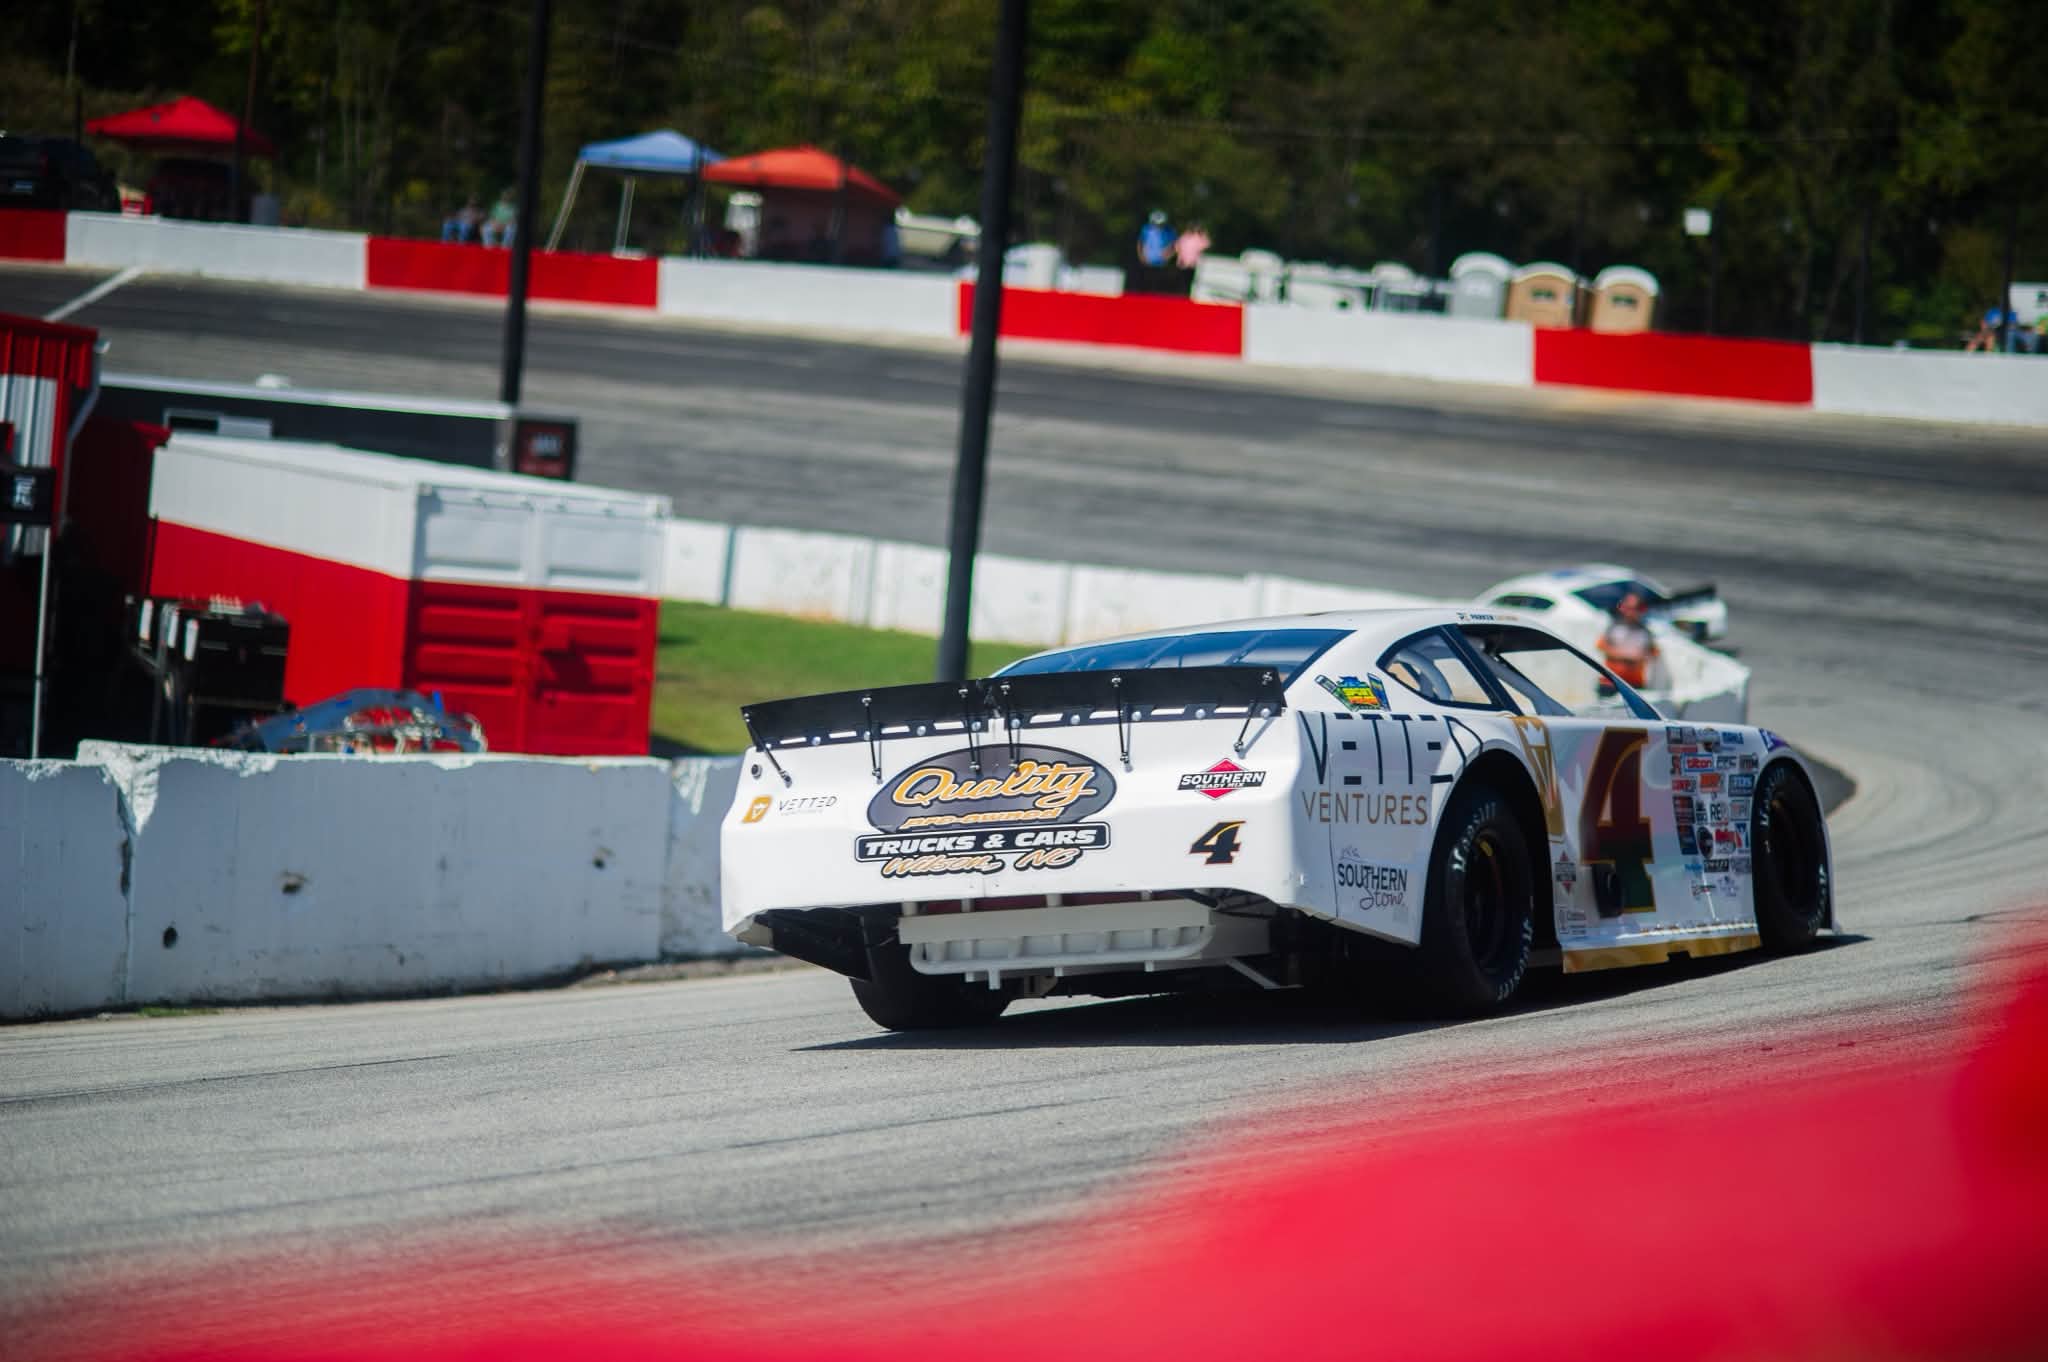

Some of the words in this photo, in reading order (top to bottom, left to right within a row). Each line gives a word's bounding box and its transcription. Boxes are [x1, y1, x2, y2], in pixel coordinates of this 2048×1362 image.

[894, 760, 1097, 808] Quality
[1181, 772, 1264, 786] SOUTHERN
[779, 796, 838, 811] VETTED
[1302, 791, 1428, 825] VENTURES
[1580, 726, 1656, 912] 4
[865, 835, 976, 856] TRUCKS
[983, 834, 1005, 849] &
[1015, 829, 1096, 847] CARS
[1189, 820, 1246, 864] 4
[1015, 848, 1079, 868] NC
[1337, 863, 1408, 892] SOUTHERN
